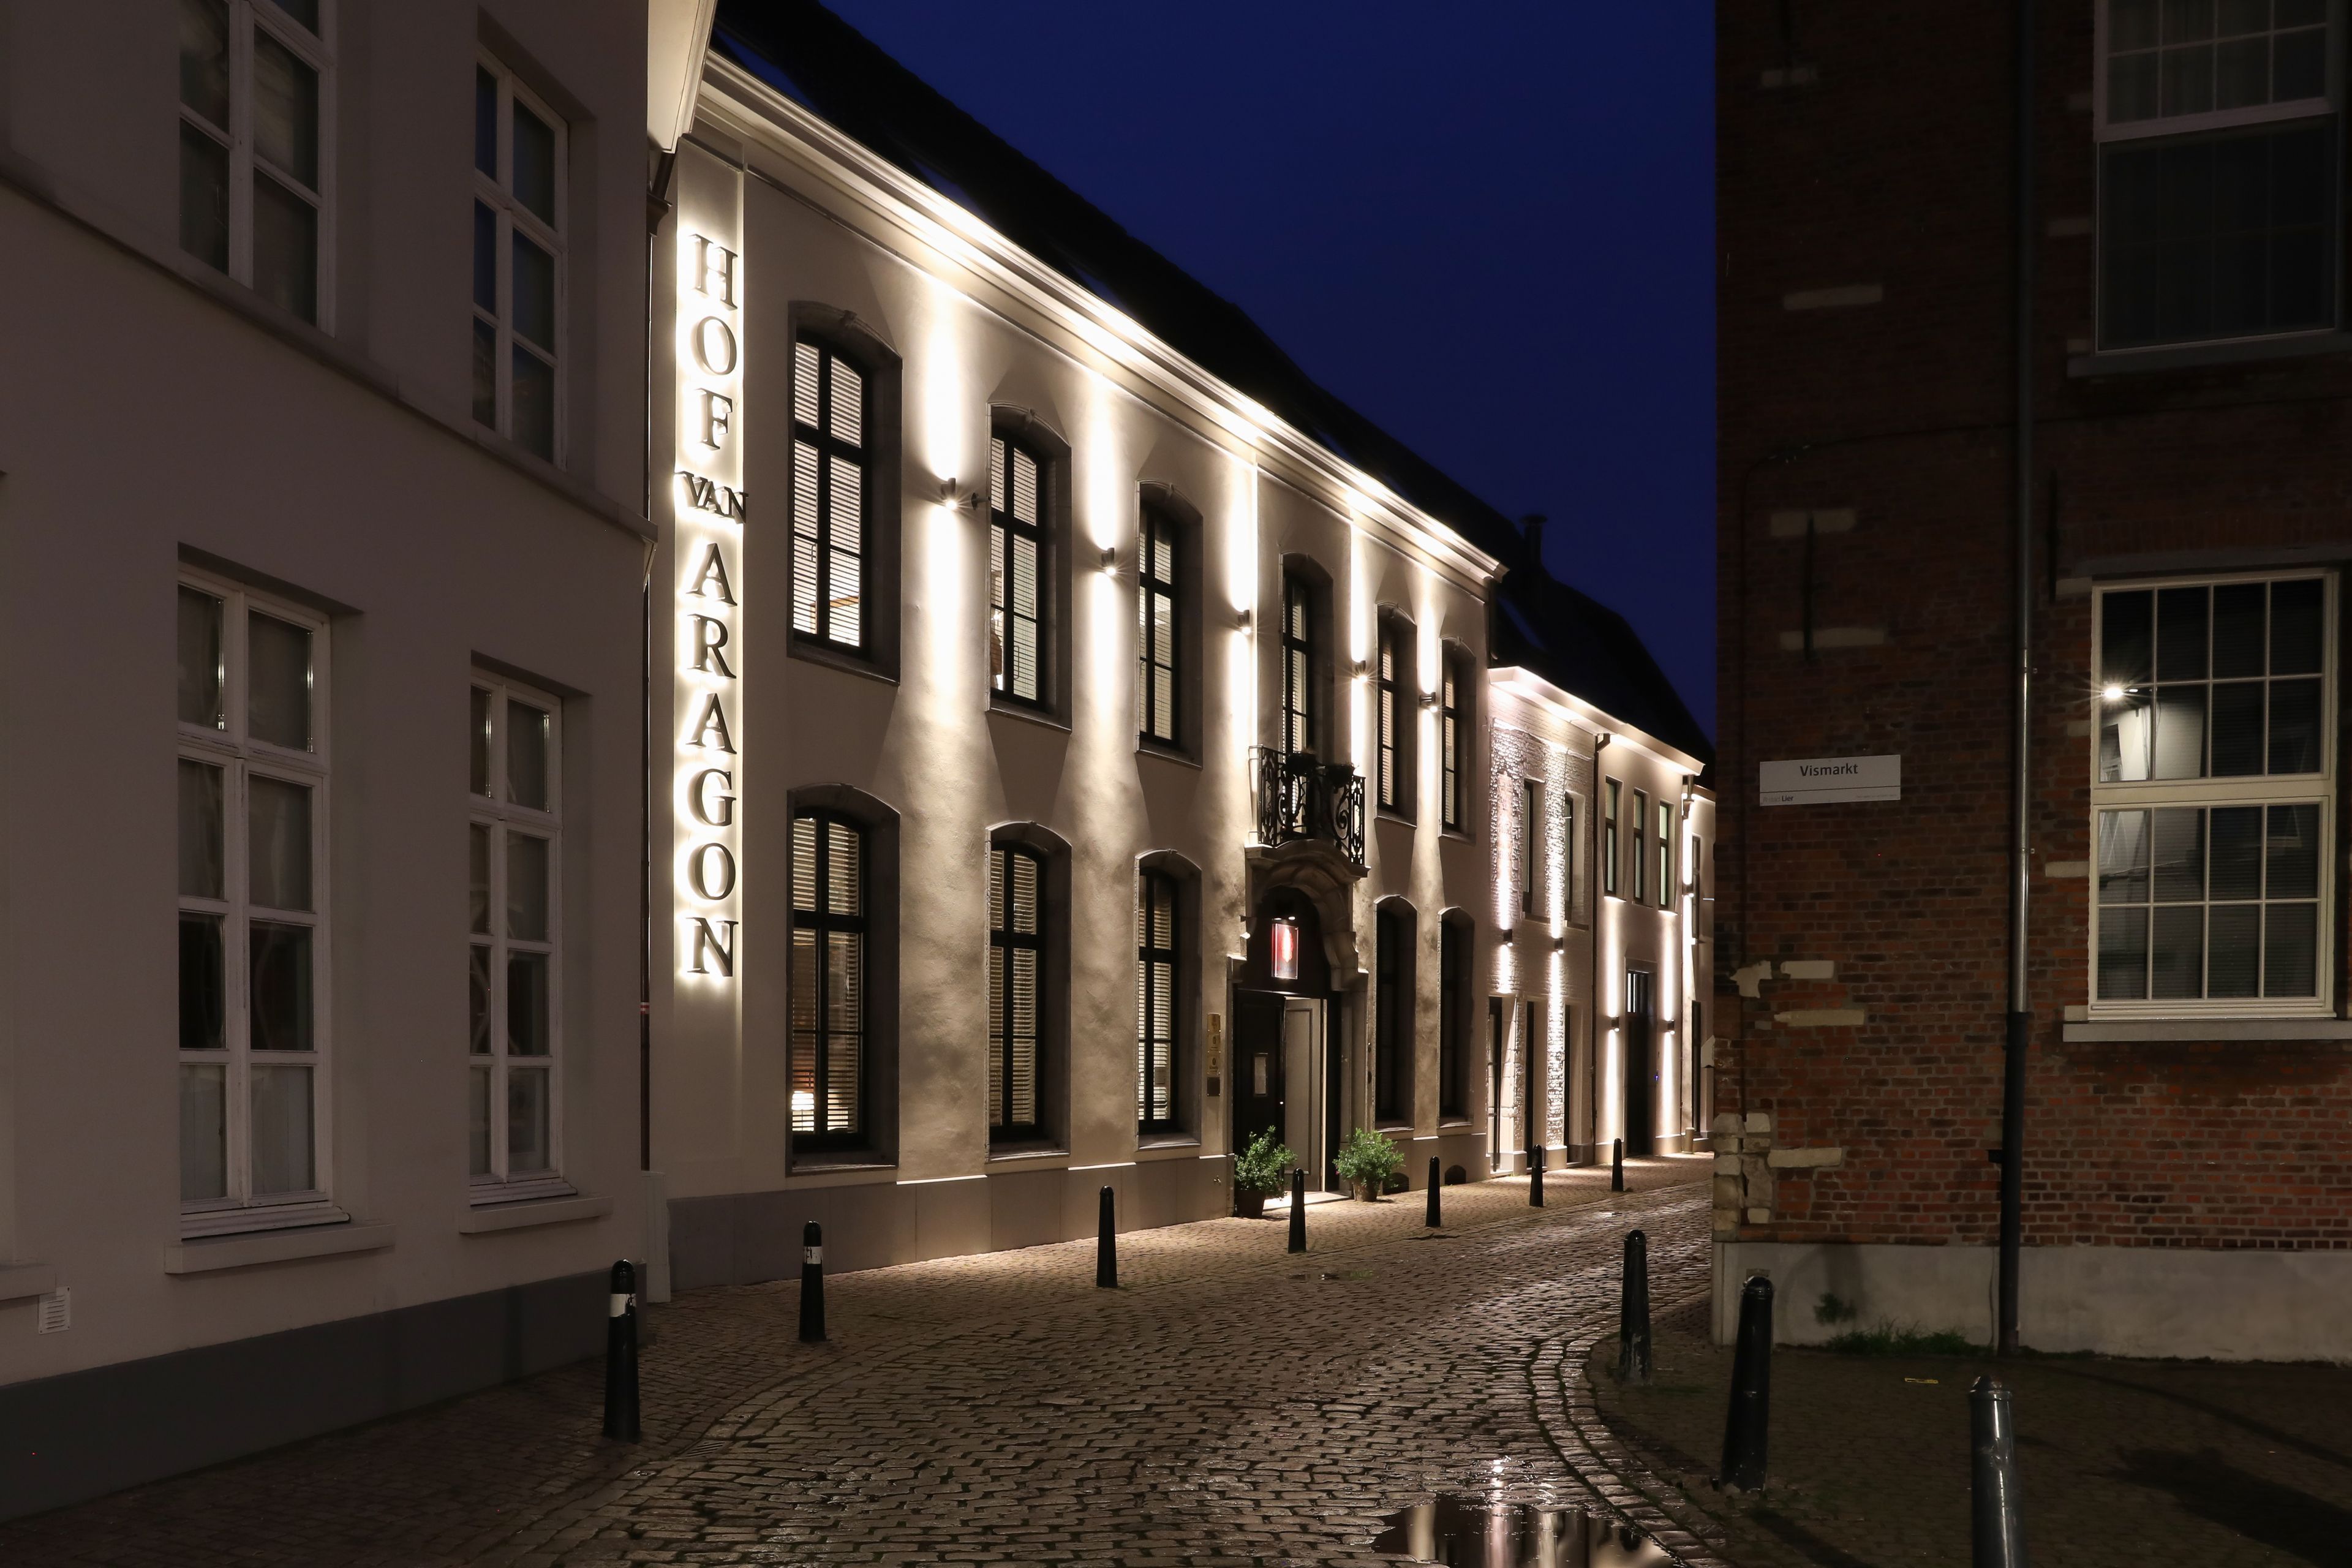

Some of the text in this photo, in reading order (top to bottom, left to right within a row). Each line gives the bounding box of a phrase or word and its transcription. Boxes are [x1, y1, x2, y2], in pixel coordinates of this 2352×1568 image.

[674, 233, 748, 978] HOF VAN ARAGON
[1800, 763, 1858, 777] Vismarkt
